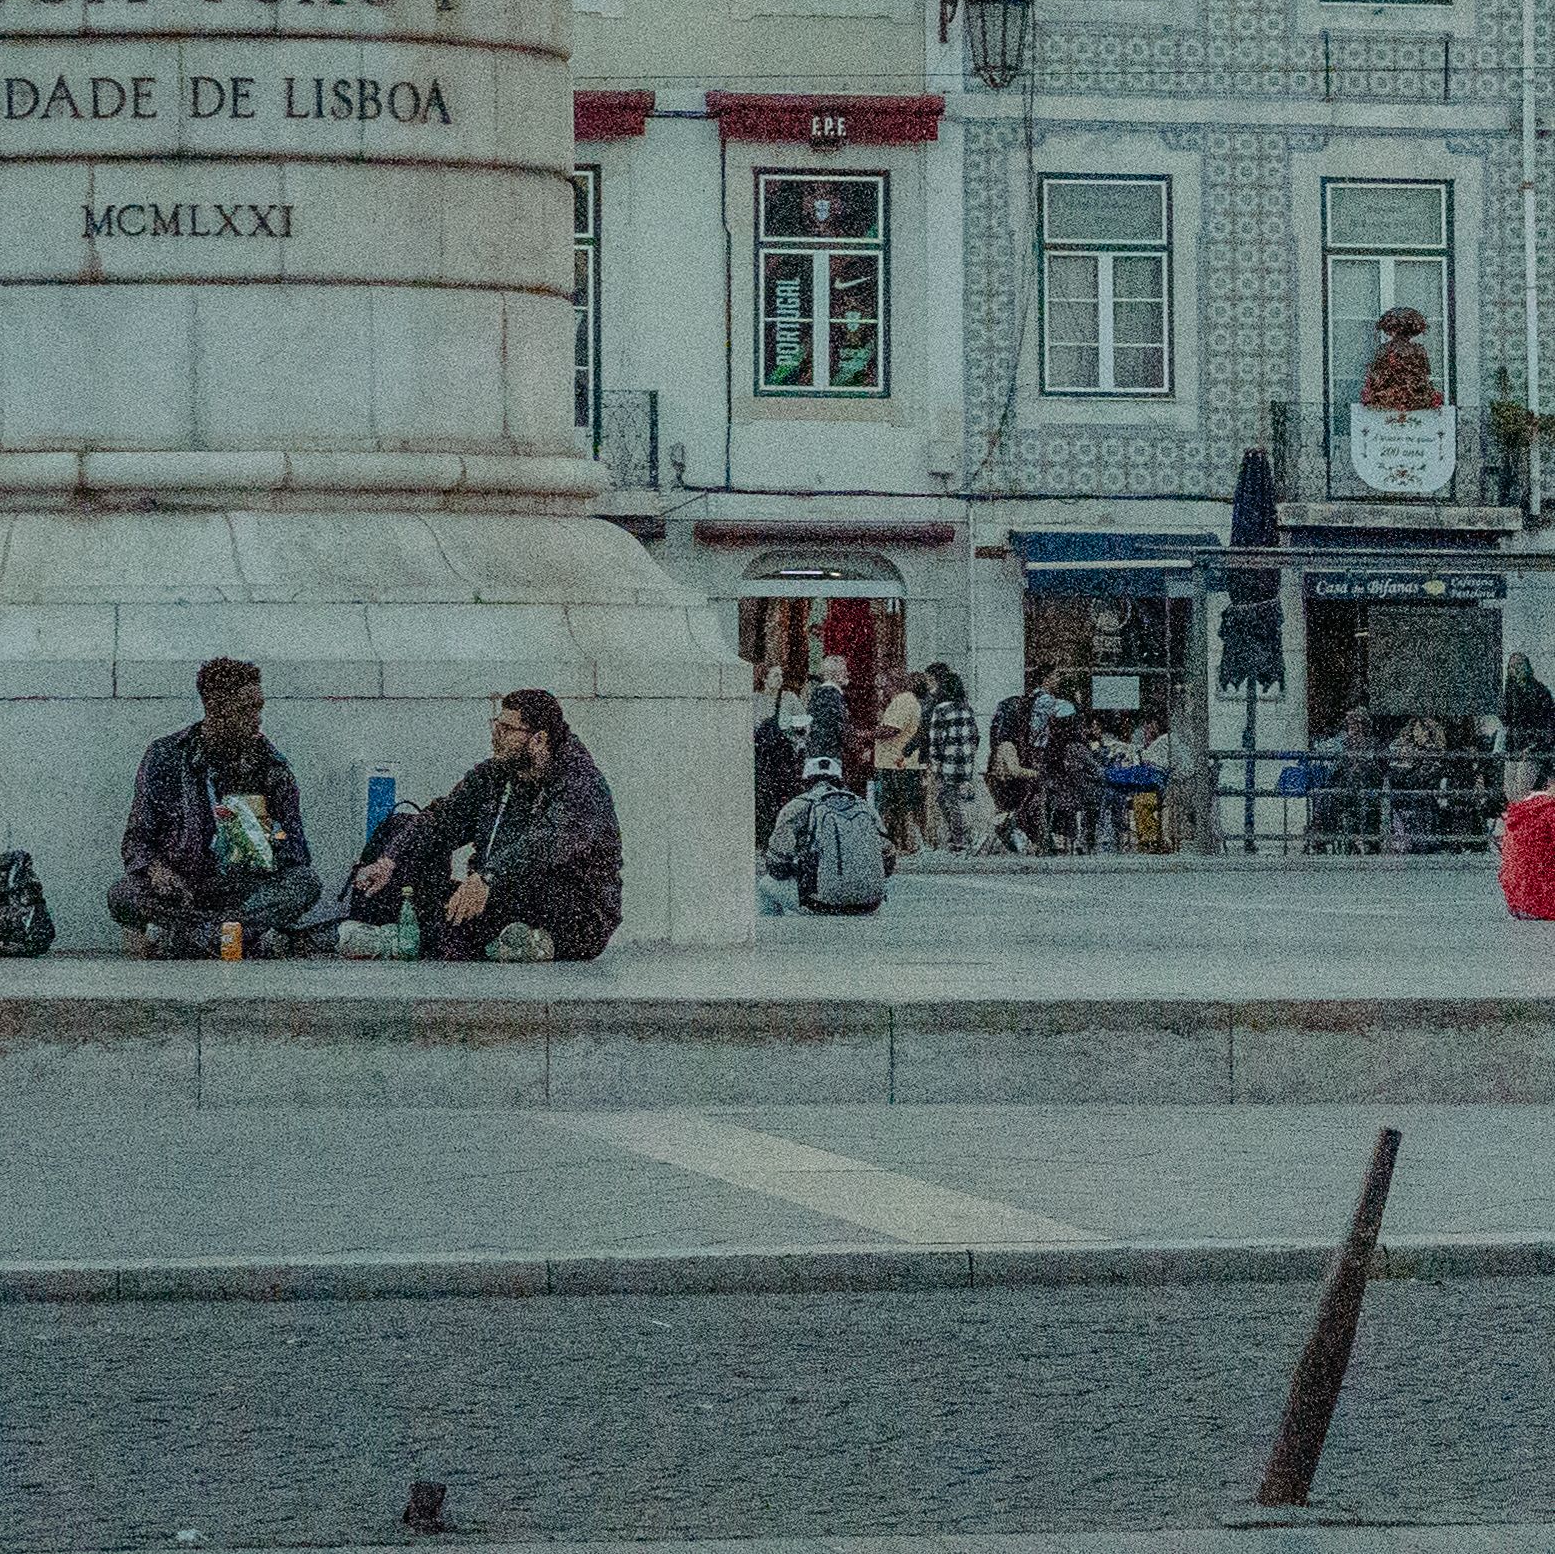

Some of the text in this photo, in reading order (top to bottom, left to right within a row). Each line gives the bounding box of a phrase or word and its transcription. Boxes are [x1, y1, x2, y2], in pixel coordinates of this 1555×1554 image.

[191, 75, 254, 119] DE
[285, 75, 451, 124] LISBOA
[83, 202, 294, 237] MCMLXXI
[776, 277, 801, 366] PORTUGAL
[1316, 581, 1348, 595] Casa
[1367, 578, 1419, 597] Bifanas
